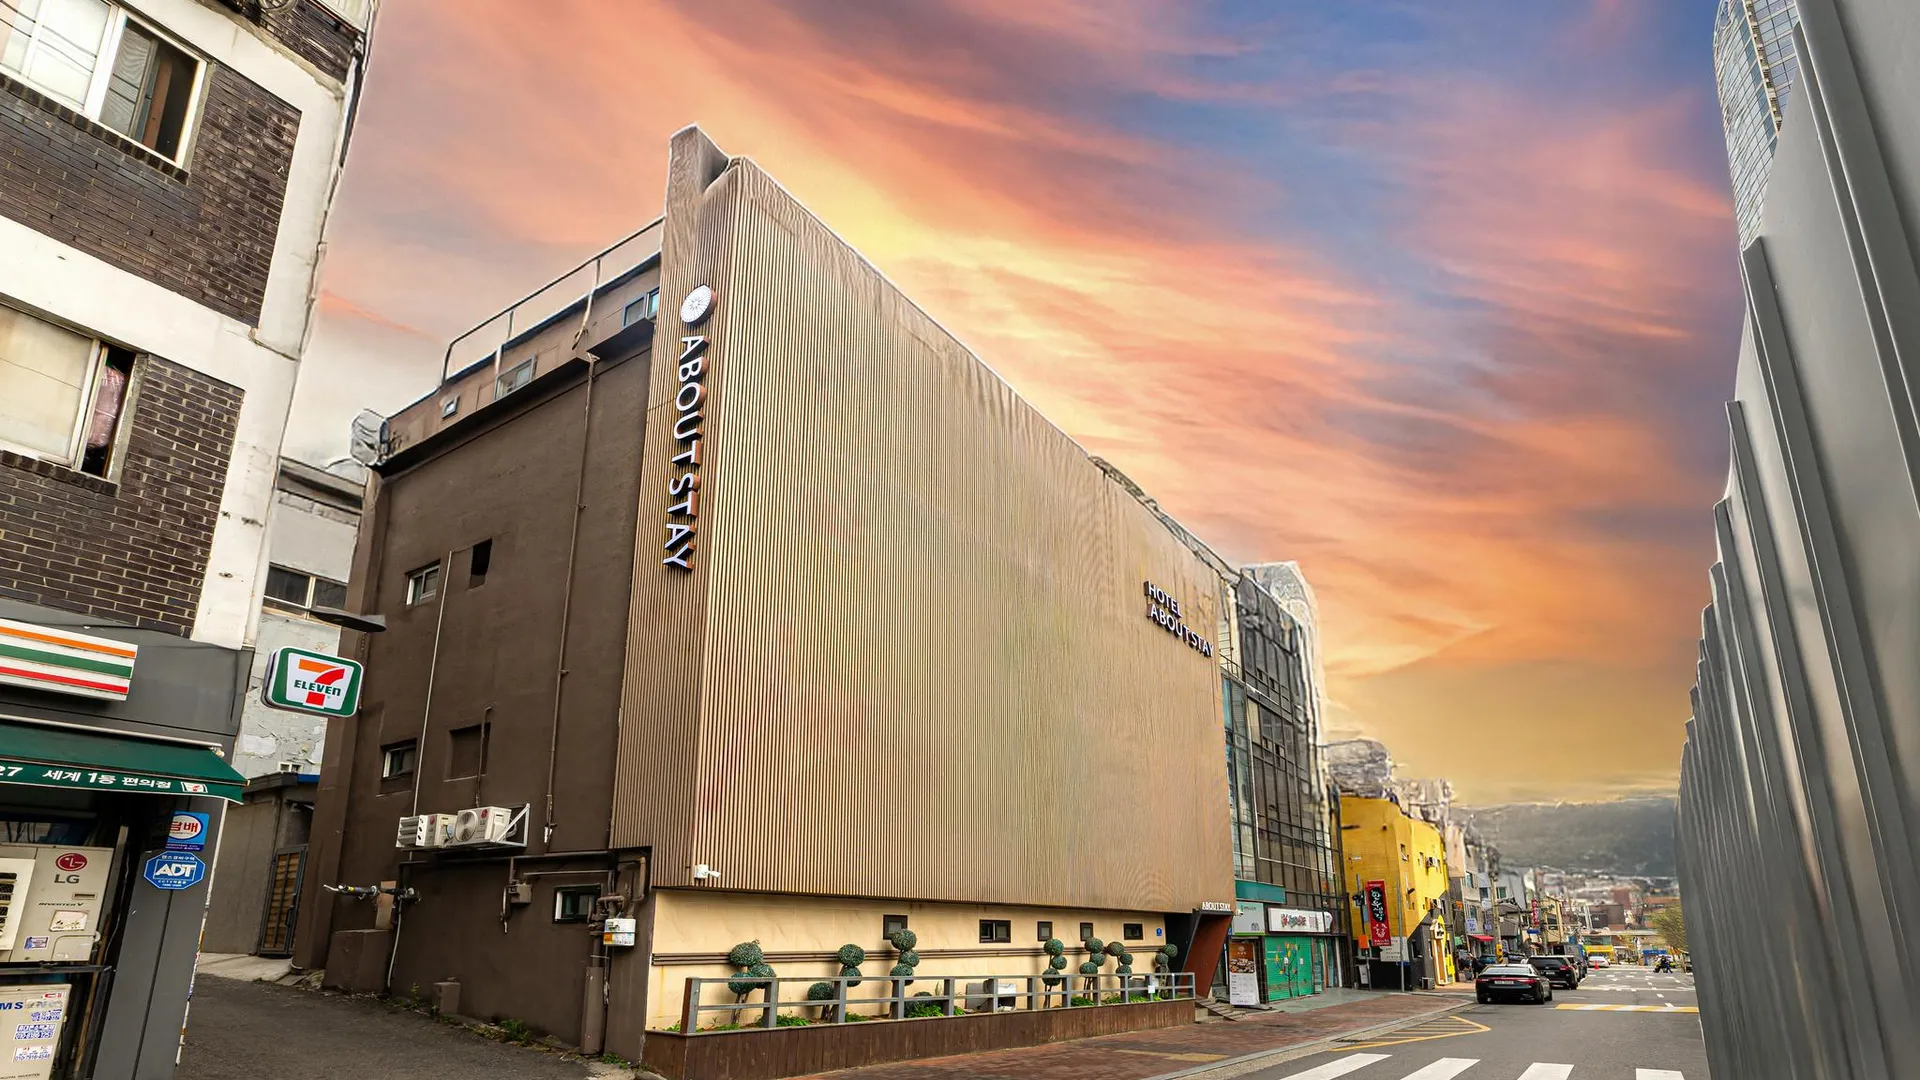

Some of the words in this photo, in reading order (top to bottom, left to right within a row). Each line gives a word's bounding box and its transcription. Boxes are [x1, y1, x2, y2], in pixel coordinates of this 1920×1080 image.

[663, 335, 708, 571] ABOUTSTAY
[1146, 580, 1183, 618] HOTEL
[1149, 604, 1214, 658] ABOUTSTAY
[298, 659, 345, 706] 7
[42, 769, 82, 782] 세계
[87, 772, 117, 785] 1등
[121, 776, 172, 789] 편의점
[54, 874, 80, 884] LG
[154, 863, 197, 878] ADT
